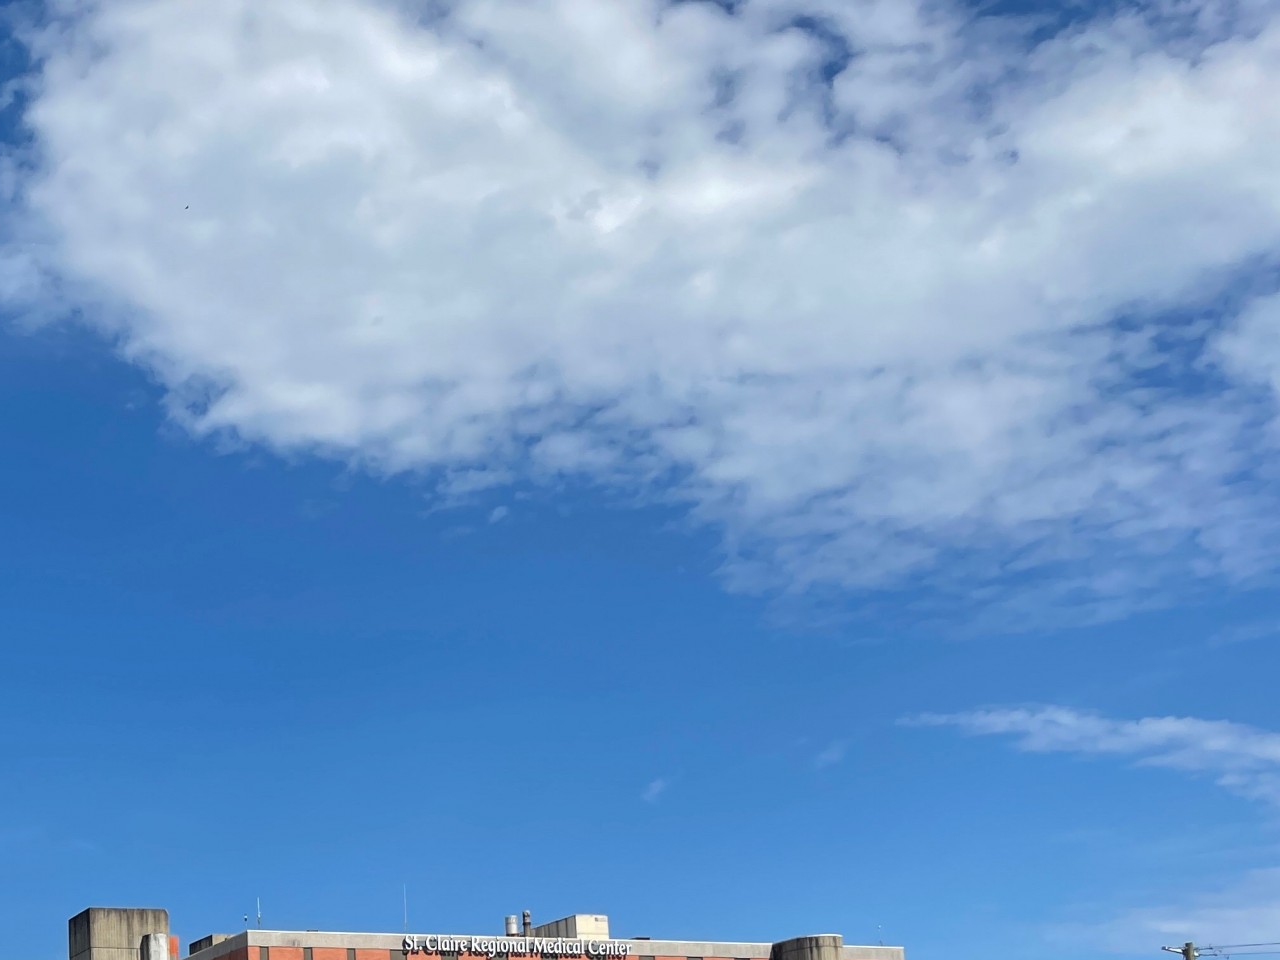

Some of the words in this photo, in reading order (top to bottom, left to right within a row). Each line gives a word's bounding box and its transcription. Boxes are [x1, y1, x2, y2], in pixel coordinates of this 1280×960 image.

[405, 934, 422, 951] St.
[425, 935, 468, 952] Claire
[471, 935, 530, 957] Regional
[534, 937, 586, 955] Medical
[588, 939, 633, 956] Center
